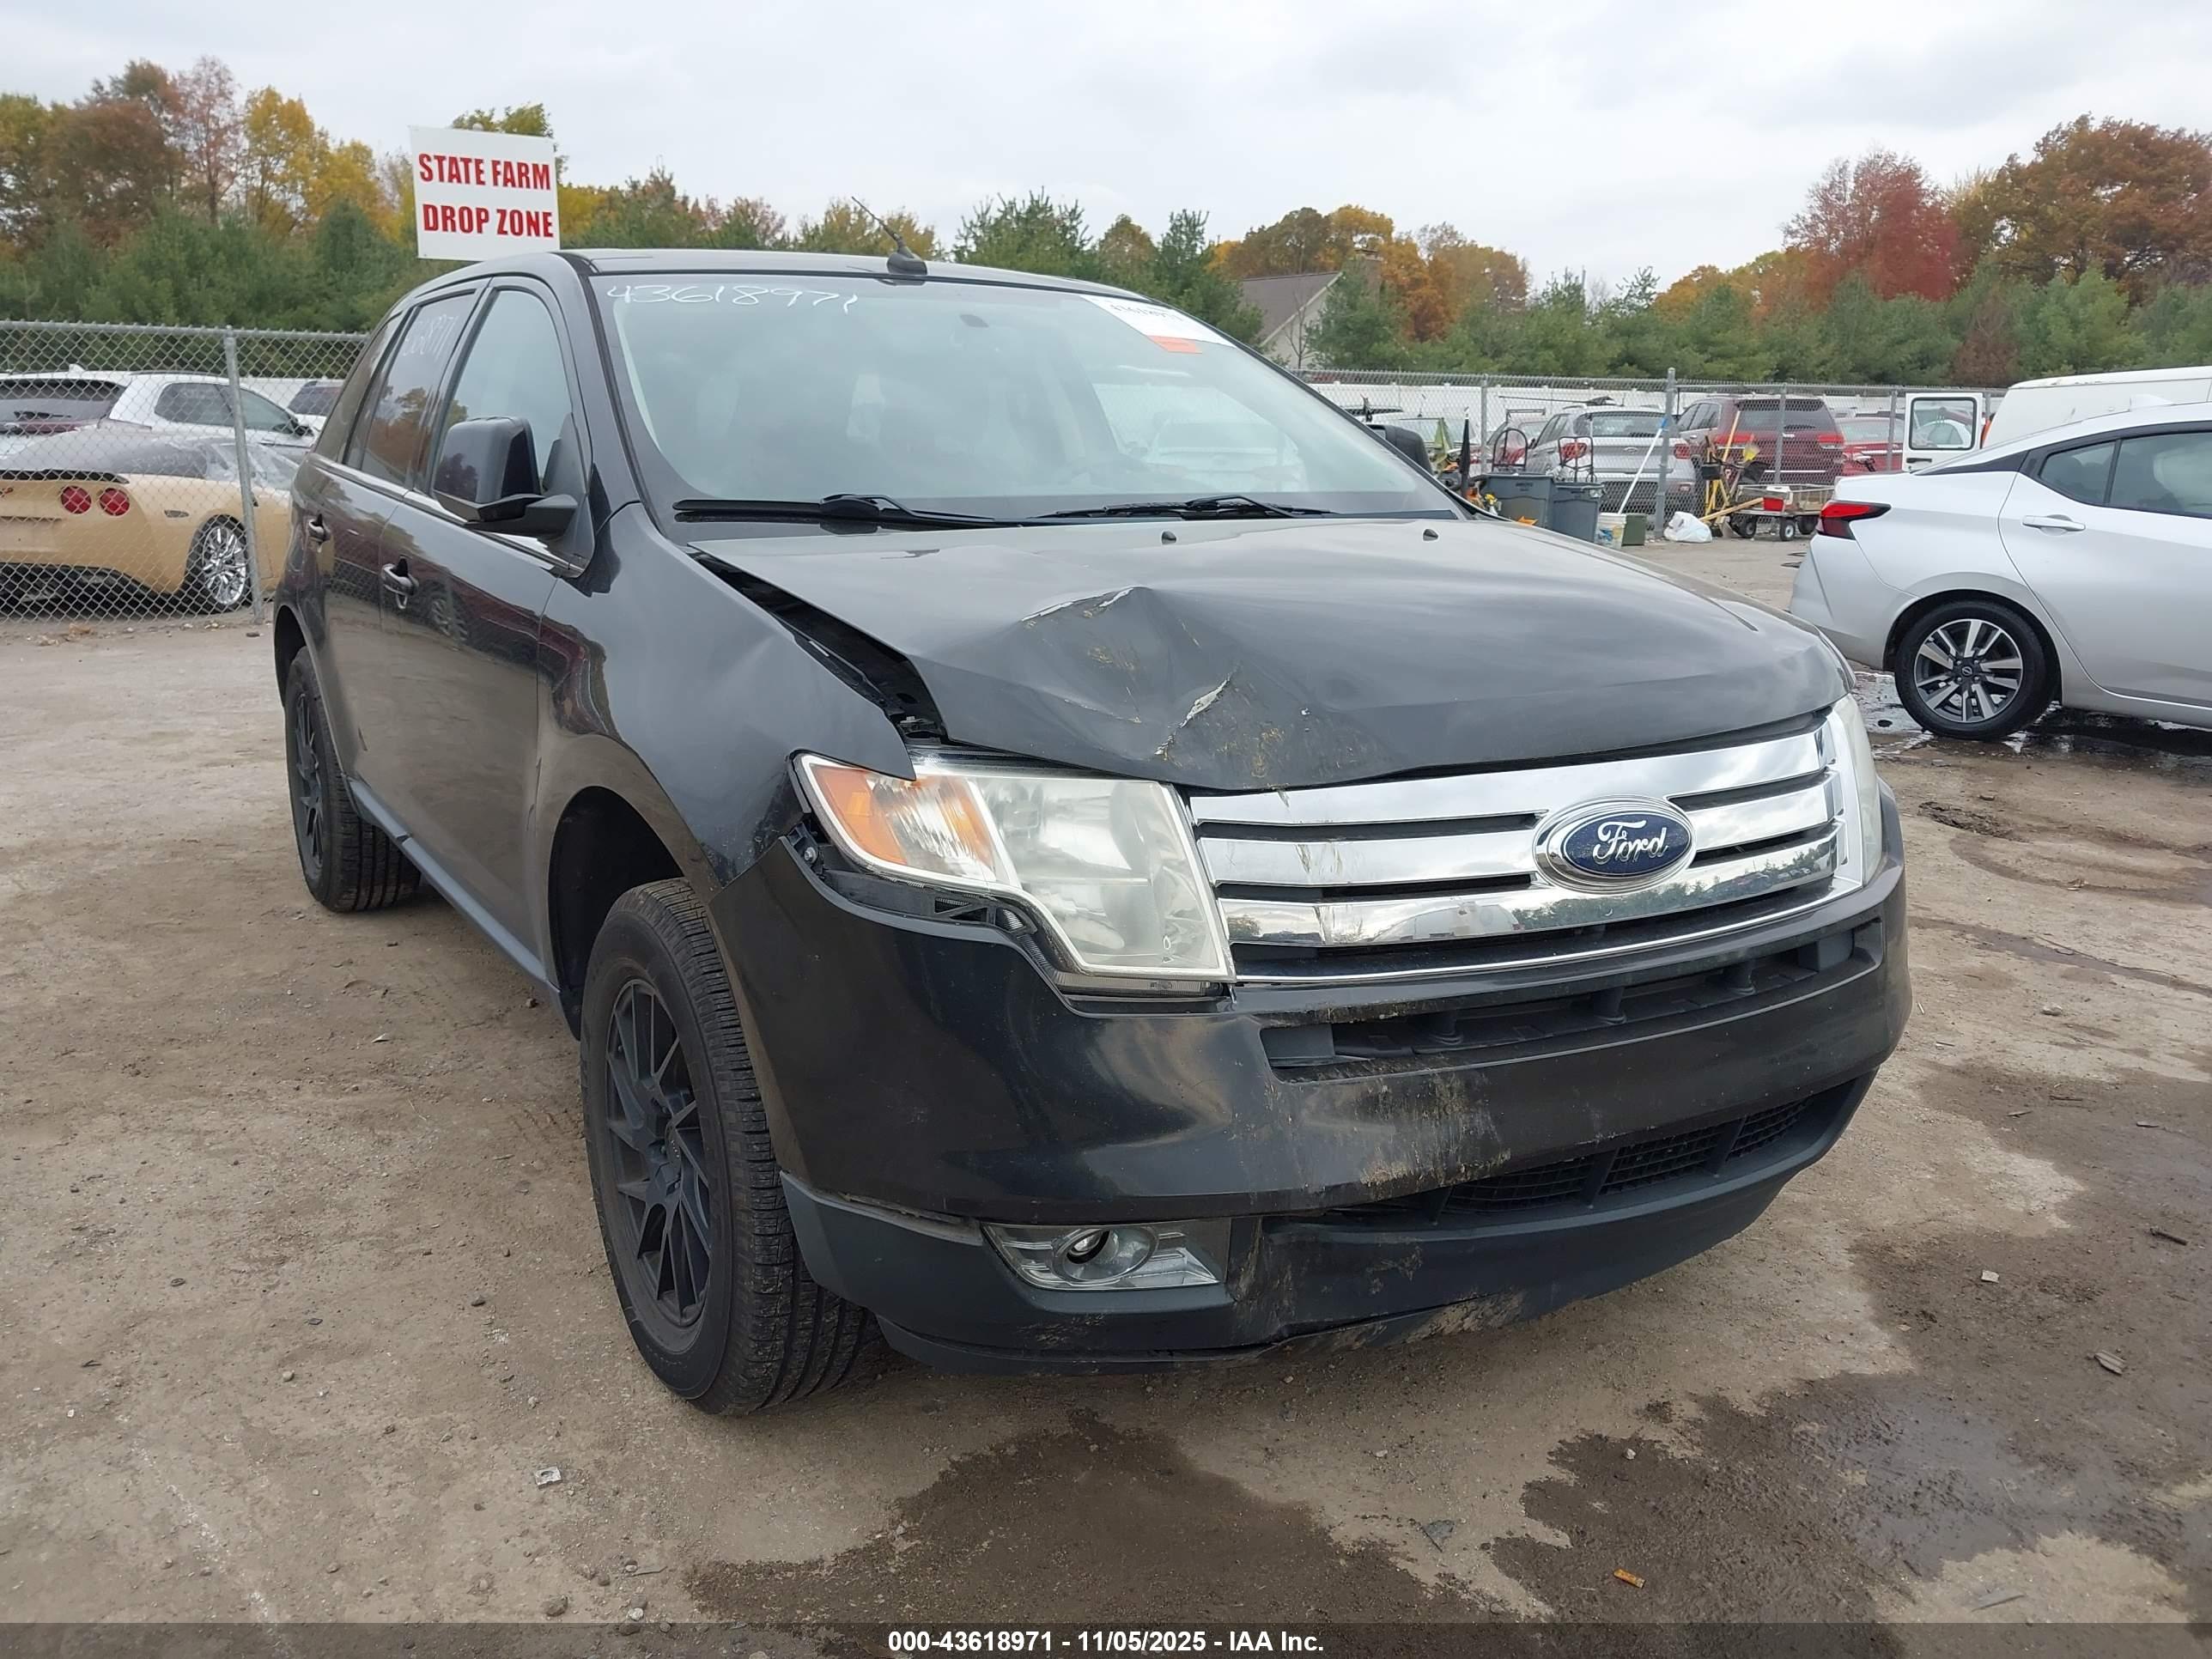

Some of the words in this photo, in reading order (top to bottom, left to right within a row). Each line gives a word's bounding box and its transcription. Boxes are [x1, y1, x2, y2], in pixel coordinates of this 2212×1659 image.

[418, 153, 486, 186] STATE
[490, 159, 552, 191] FARM
[422, 204, 489, 234] DROP
[495, 209, 554, 238] ZONE
[606, 284, 859, 315] 43618971
[1592, 819, 1670, 865] Ford
